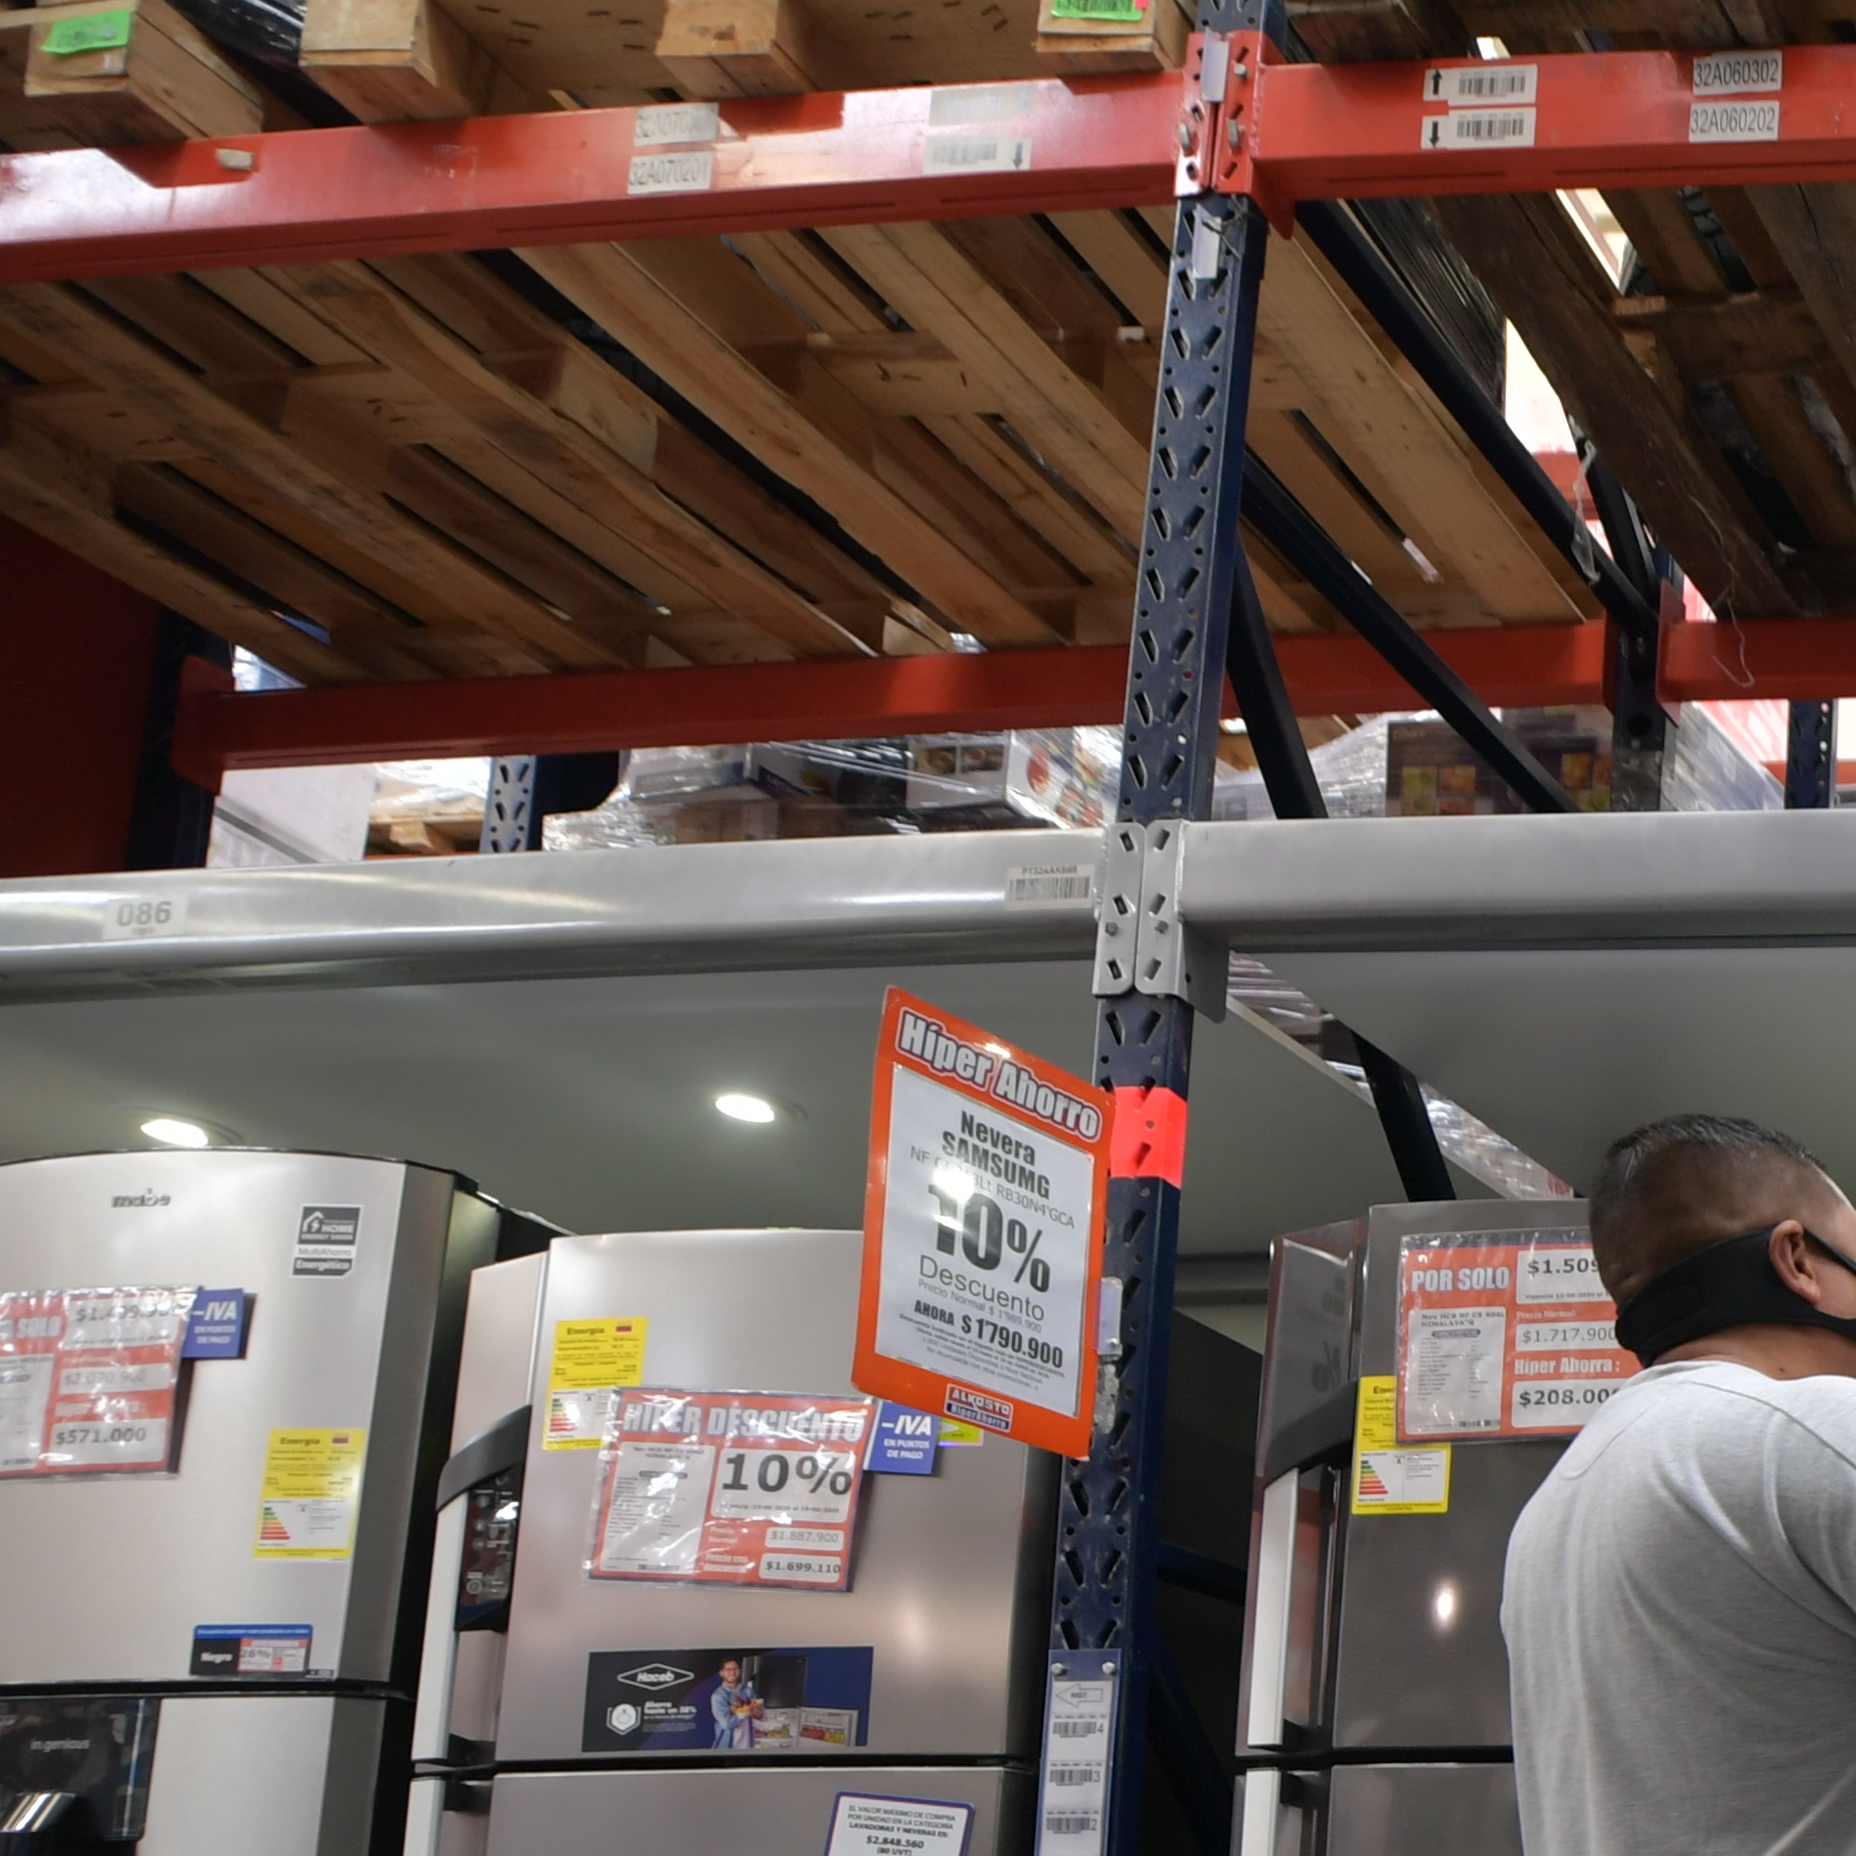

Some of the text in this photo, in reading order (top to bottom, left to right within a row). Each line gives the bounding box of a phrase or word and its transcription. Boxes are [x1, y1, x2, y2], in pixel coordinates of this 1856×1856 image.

[1694, 58, 1780, 88] 32A060302
[1690, 105, 1776, 134] 32A060202
[628, 157, 710, 188] 32A070201
[116, 900, 172, 927] 086
[899, 1009, 1100, 1140] Híper Ahorro
[960, 1109, 1036, 1167] Nevera
[941, 1130, 1051, 1200] SAMSUMG
[927, 1183, 1051, 1293] 10%
[919, 1253, 1045, 1322] Descuento
[1410, 1265, 1512, 1293] POR SOLO
[917, 1277, 986, 1313] Precio Normal
[914, 1299, 955, 1327] AHORA
[960, 1314, 972, 1335] $
[1521, 1326, 1616, 1345] $1.717.900
[1514, 1356, 1612, 1376] Híper Ahorra
[951, 1388, 1010, 1415] ALKOSTO
[621, 1401, 702, 1436] HIPER
[54, 1426, 147, 1446] $571.000
[721, 1452, 853, 1496] 10%
[764, 1560, 841, 1575] $1.699.110
[30, 1736, 91, 1752] in.genious
